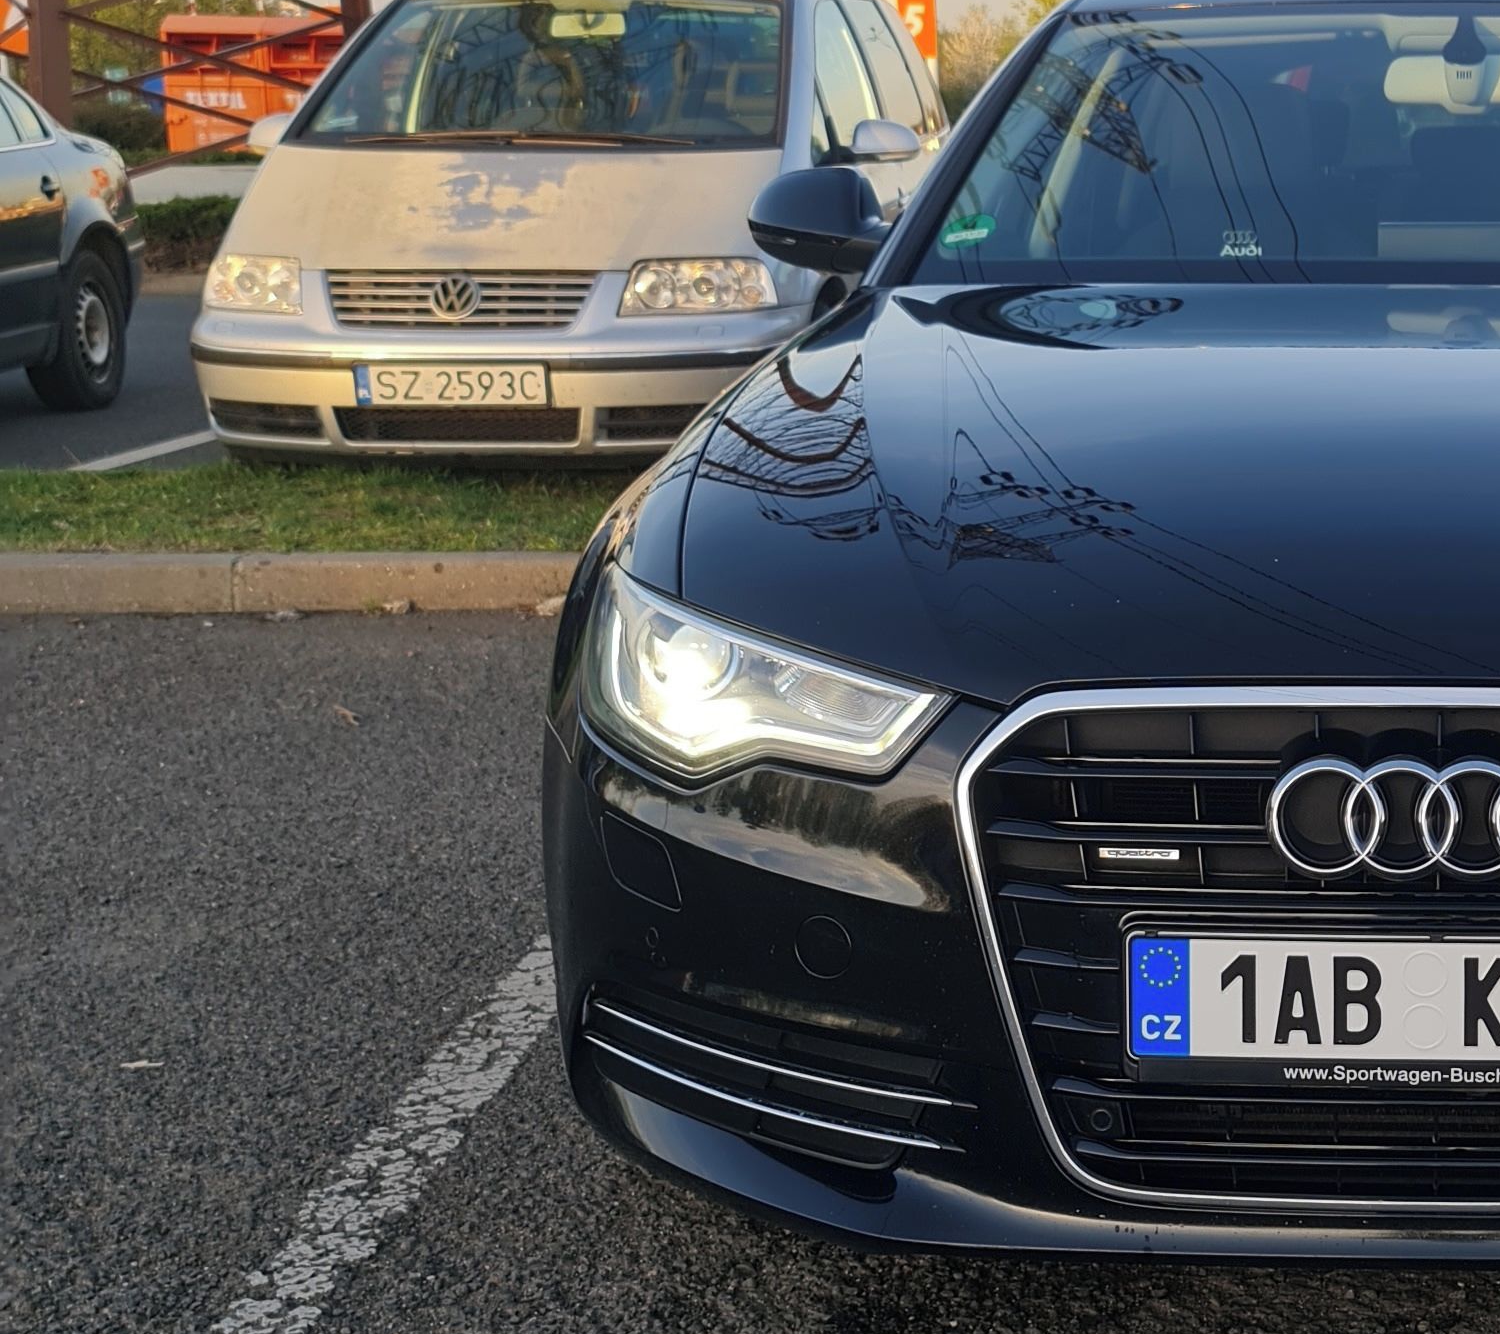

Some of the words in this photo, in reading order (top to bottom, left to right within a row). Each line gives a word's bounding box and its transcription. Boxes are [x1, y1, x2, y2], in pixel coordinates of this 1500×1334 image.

[1220, 244, 1263, 258] Audi
[376, 370, 425, 401] SZ
[435, 370, 540, 402] 2593C
[1107, 849, 1171, 858] quattro
[1221, 953, 1383, 1046] 1AB
[1140, 1014, 1183, 1041] CZ
